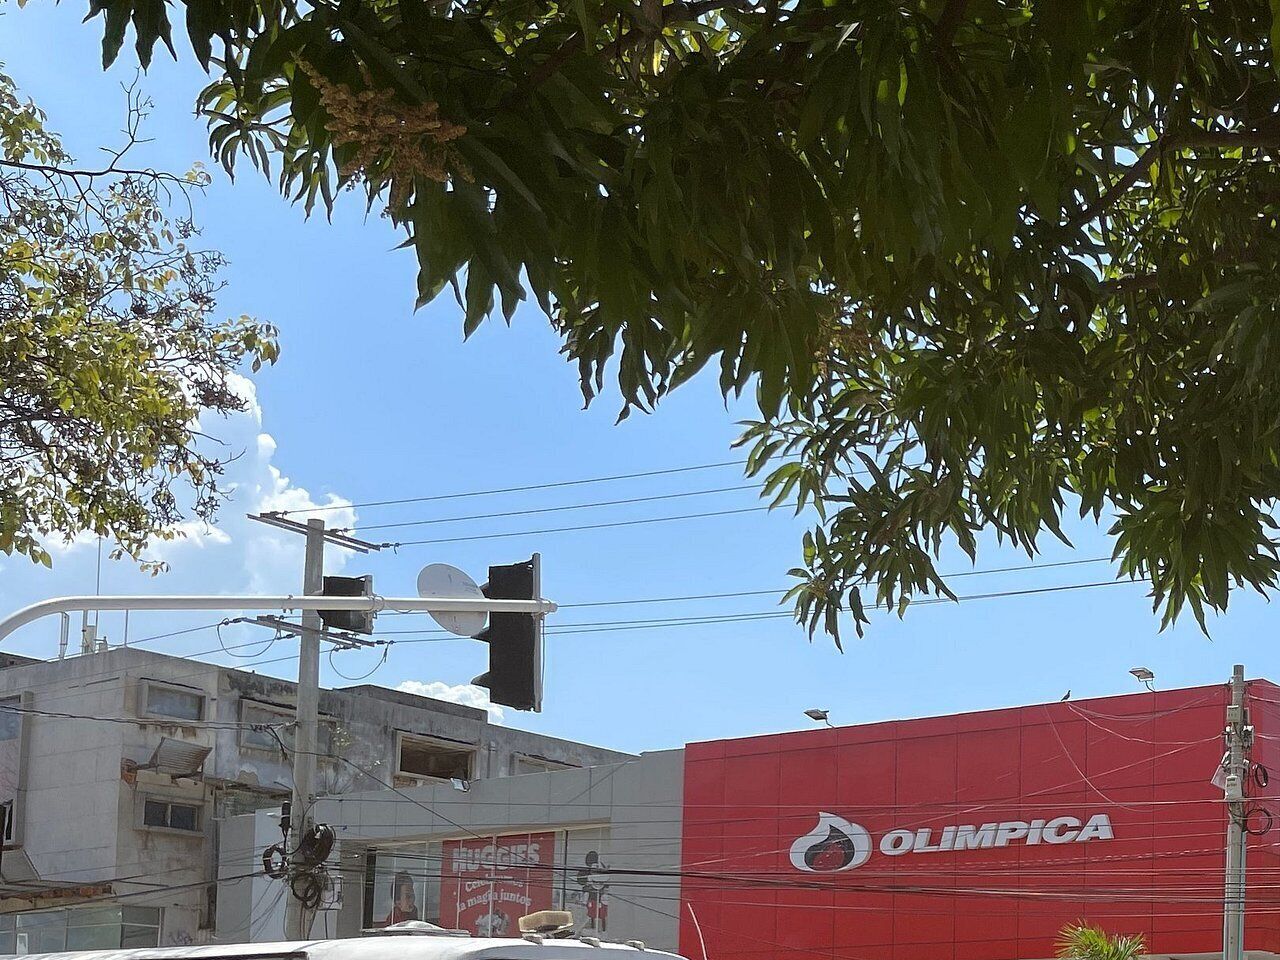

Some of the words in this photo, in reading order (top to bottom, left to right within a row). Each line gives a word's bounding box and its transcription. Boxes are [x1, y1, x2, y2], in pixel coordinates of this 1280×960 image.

[879, 814, 1114, 855] OLIMPICA
[452, 843, 540, 873] HUGGIES
[498, 889, 532, 906] juntos
